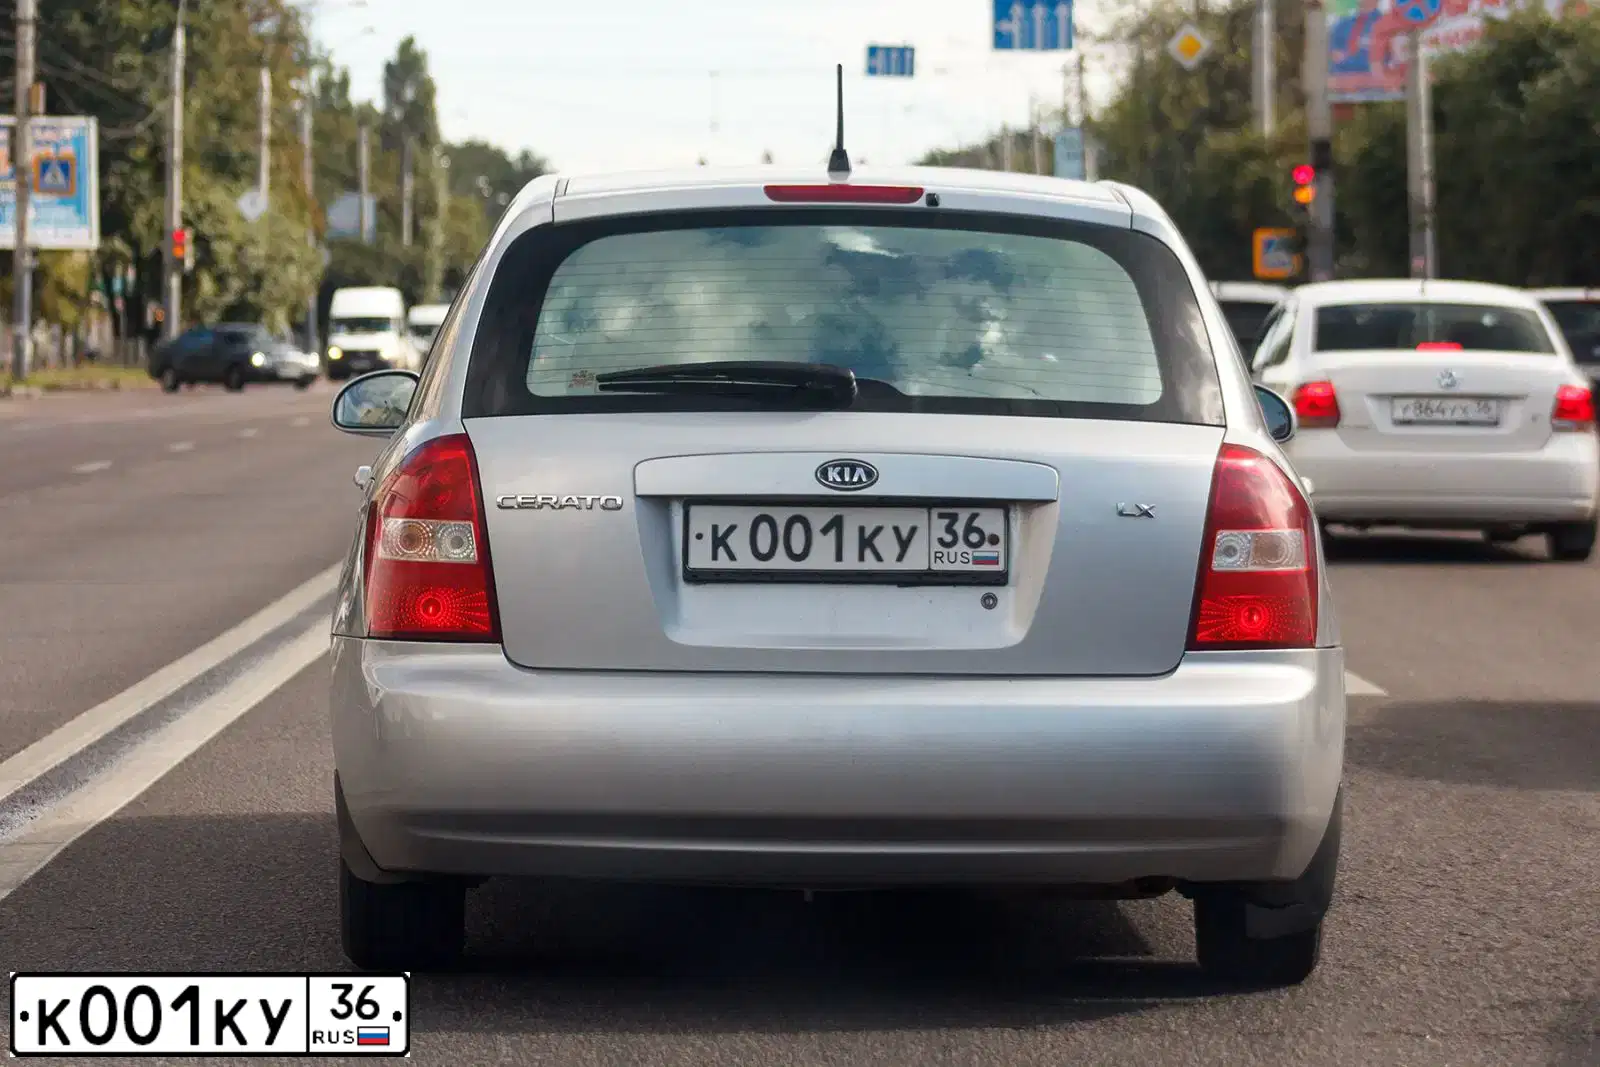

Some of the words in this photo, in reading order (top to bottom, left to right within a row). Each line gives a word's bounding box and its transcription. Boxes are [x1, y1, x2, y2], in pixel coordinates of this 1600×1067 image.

[827, 466, 867, 481] KIA
[496, 494, 623, 510] CERATO
[1116, 502, 1156, 518] LX
[937, 512, 986, 549] 36
[934, 551, 970, 564] RUS
